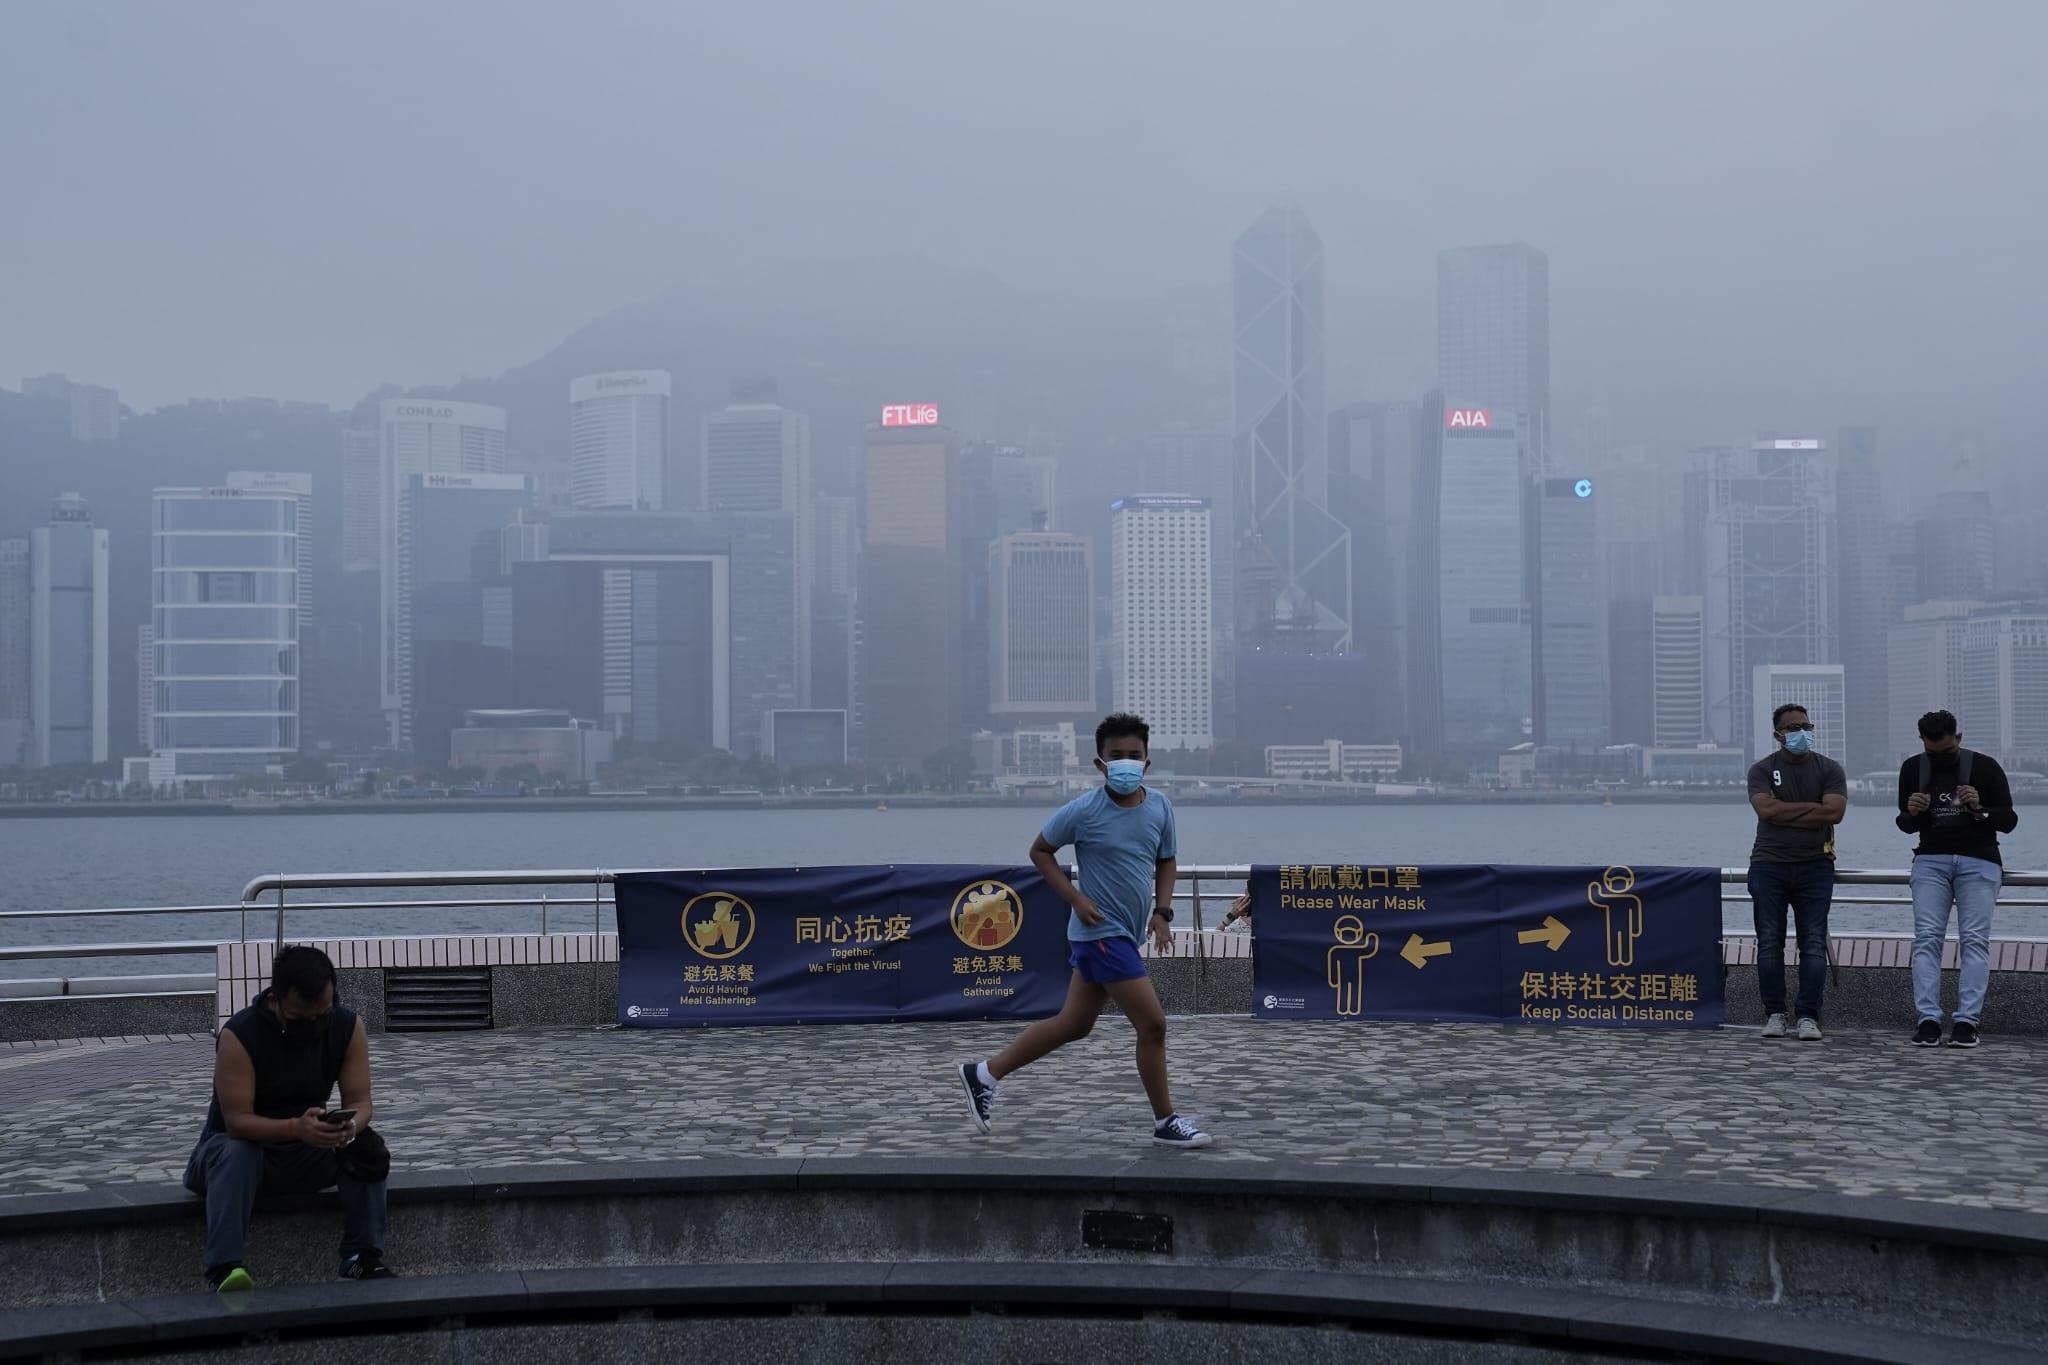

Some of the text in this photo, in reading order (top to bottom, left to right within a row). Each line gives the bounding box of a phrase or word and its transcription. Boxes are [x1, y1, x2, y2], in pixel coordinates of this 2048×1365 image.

[397, 406, 454, 418] CONRAD
[882, 404, 938, 425] FTLife
[1450, 410, 1487, 427] AIA
[1772, 769, 1782, 786] 9
[1279, 864, 1422, 891] 請佩戴口罩
[1281, 894, 1427, 910] Please Wear Mask
[795, 914, 913, 944] 同心抗疫
[808, 960, 901, 974] We Fight the Virus!
[952, 954, 1024, 974] 避免聚集
[683, 964, 755, 983] 避免聚餐
[975, 976, 1002, 985] Avoid
[688, 984, 749, 996] Avoid Having
[963, 987, 1015, 997] Gatherings
[1519, 971, 1698, 1002] 保持社交距離
[680, 995, 757, 1006] Meal Gatherings
[1521, 1004, 1695, 1021] Keep Social Distance
